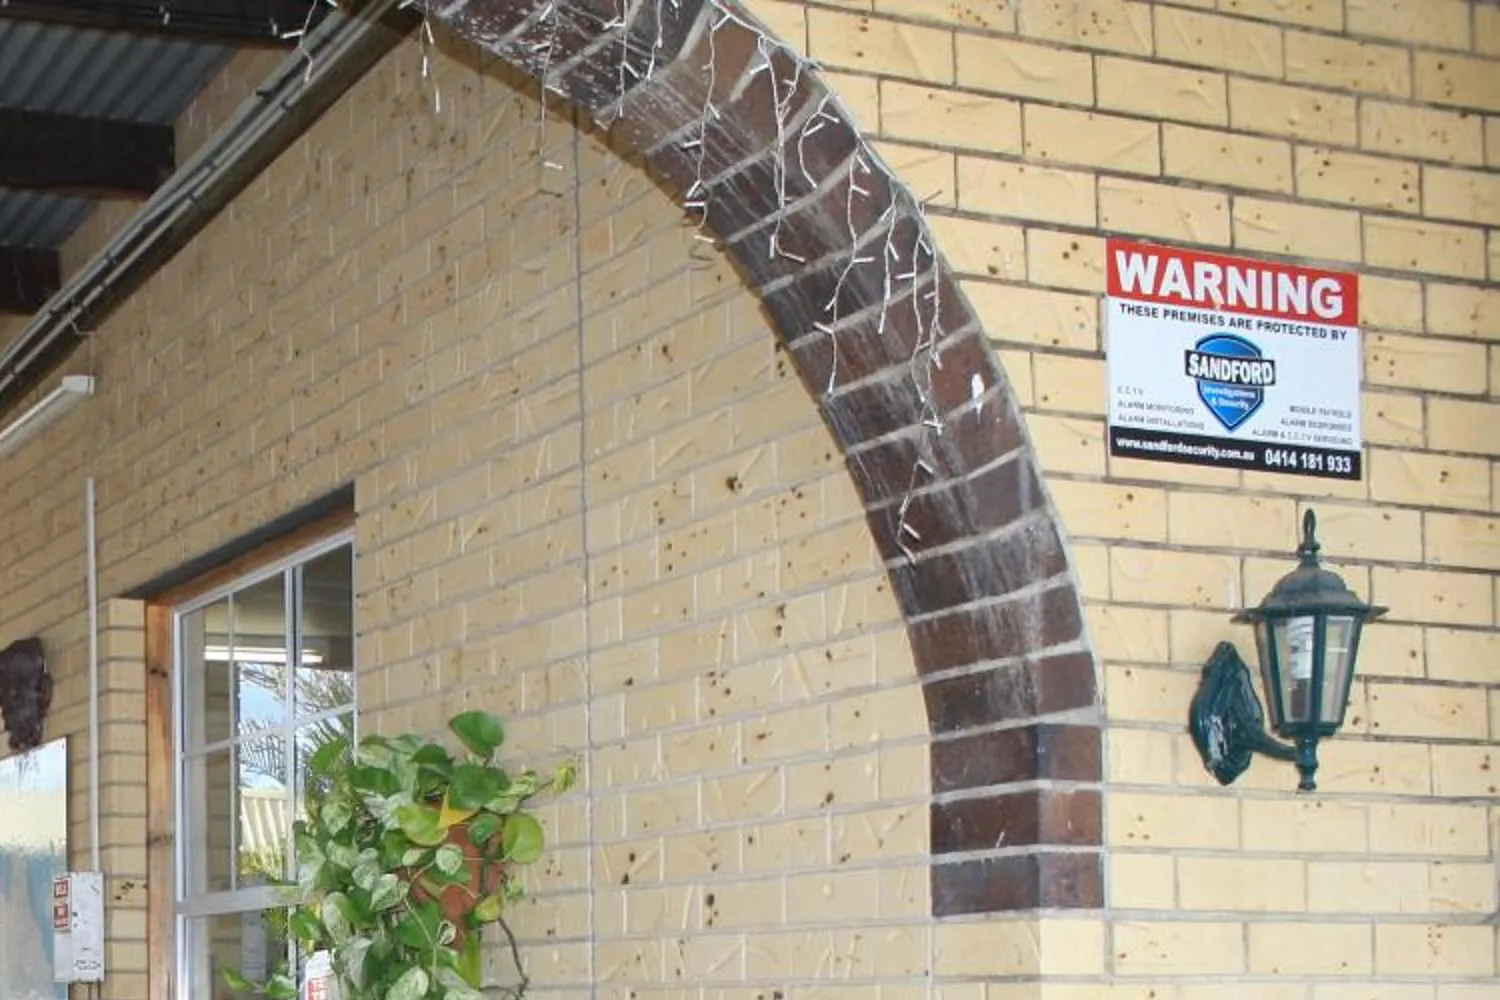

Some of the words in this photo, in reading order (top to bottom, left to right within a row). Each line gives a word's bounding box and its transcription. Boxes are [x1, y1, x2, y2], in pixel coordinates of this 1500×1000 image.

[1115, 249, 1344, 319] WARNING
[1120, 303, 1158, 319] THESE
[1163, 308, 1225, 327] PREMISES
[1229, 316, 1252, 331] ARE
[1257, 319, 1327, 339] PROTECTED
[1331, 329, 1347, 341] BY
[1188, 353, 1274, 384] SANDFORD
[1116, 437, 1255, 462] www.sandfordsecurity.com.au
[1266, 449, 1297, 469] 0414
[1300, 453, 1324, 471] 181
[1327, 456, 1351, 473] 933
